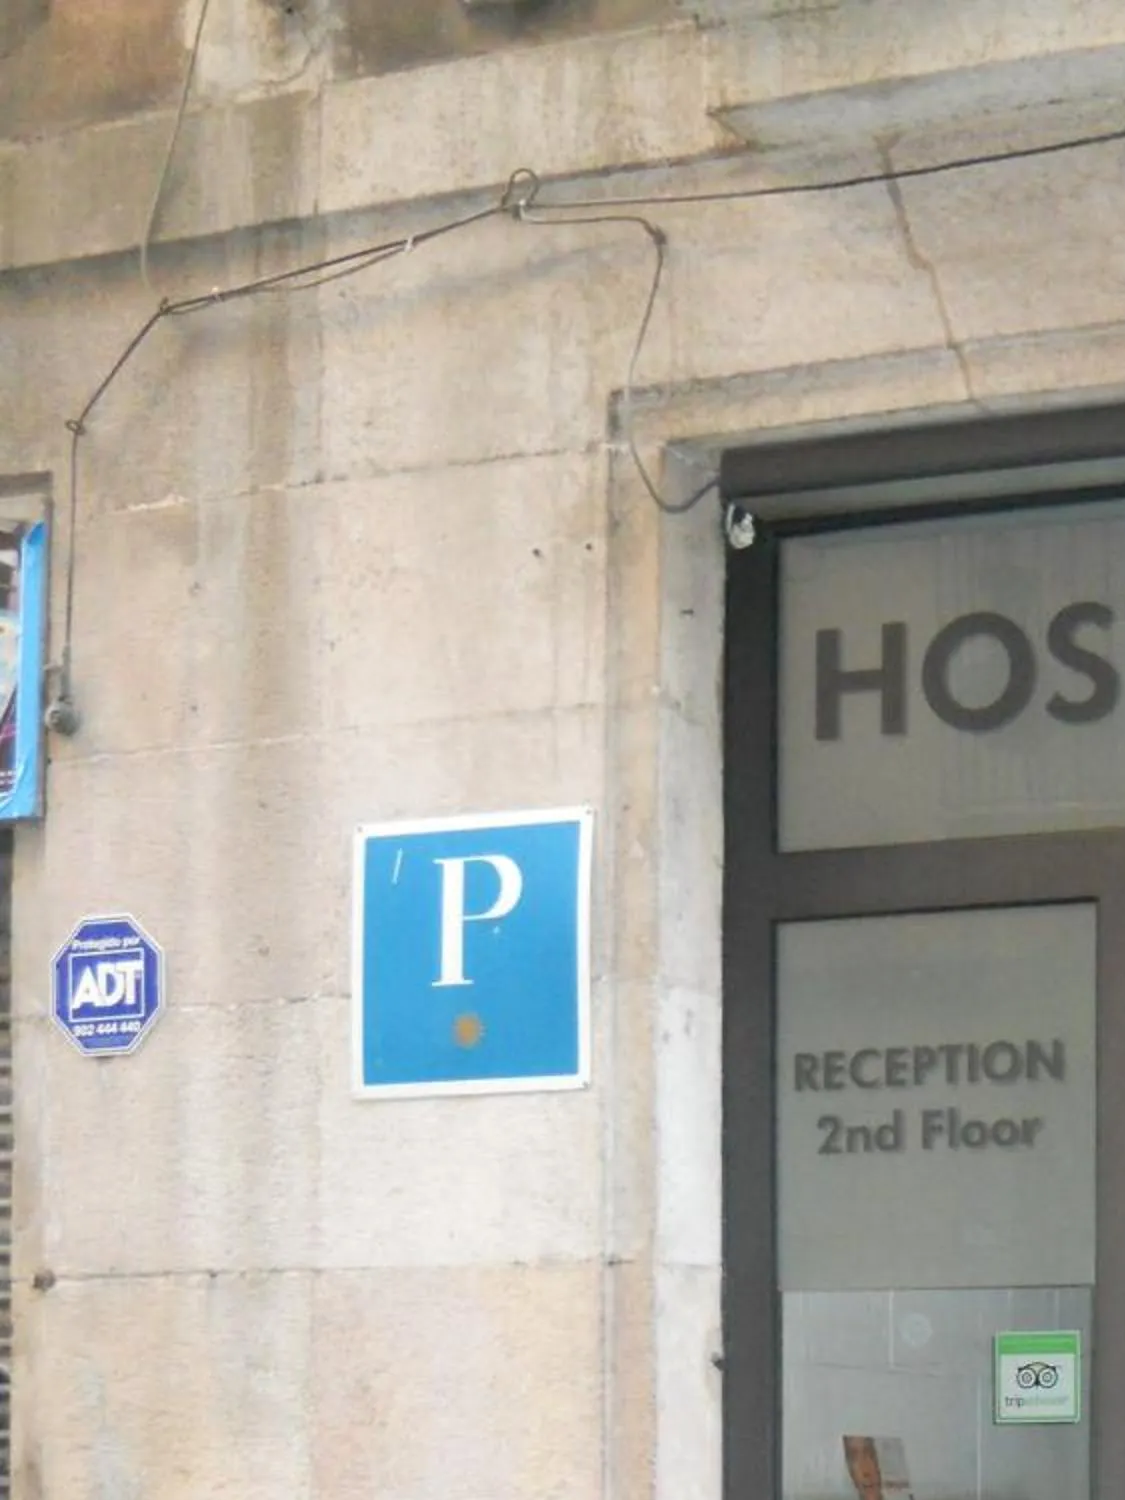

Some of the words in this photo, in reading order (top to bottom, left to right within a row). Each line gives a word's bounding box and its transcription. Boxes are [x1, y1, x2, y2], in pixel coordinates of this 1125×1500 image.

[431, 853, 523, 988] P
[71, 960, 144, 1010] ADT
[794, 1037, 1066, 1092] RECEPTION
[816, 1108, 905, 1155] 2nd
[920, 1106, 1044, 1151] Floor
